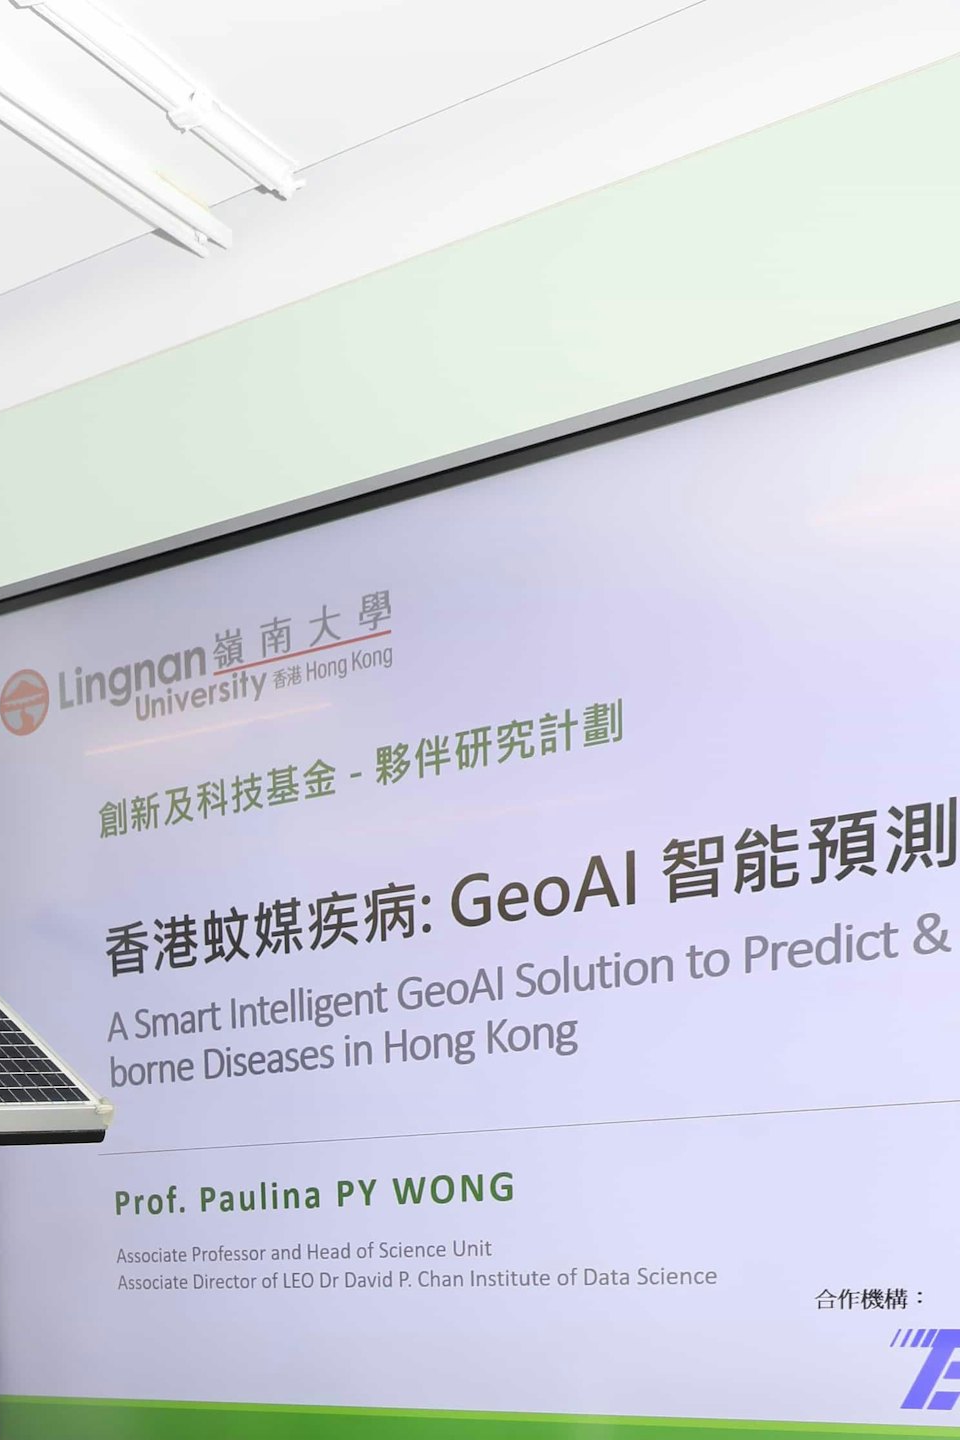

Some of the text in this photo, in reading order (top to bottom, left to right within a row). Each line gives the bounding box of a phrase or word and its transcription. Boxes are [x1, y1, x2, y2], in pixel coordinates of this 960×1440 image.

[212, 590, 392, 667] 嶺南大學
[58, 644, 207, 710] Lingnan
[135, 669, 268, 722] University
[272, 645, 393, 690] 香港 Hong Kong
[99, 758, 337, 839] 創新及科技基金
[376, 698, 624, 787] 夥伴研究計劃
[105, 797, 959, 978] 香港蚊媒疾病: GeoAI 智能預測
[108, 912, 952, 1042] A Smart Intelligent GeoAI Solution to Predict &
[110, 1019, 579, 1087] borne Diseases in Hong Kong
[115, 1171, 515, 1215] Prof. Paulina PY WONG
[117, 1239, 492, 1264] Associate Professor and Head of Science Unit
[118, 1267, 718, 1291] Associate Director of LEO Dr David P. Chan Institute of Data Science
[815, 1288, 922, 1310] 合作機構：
